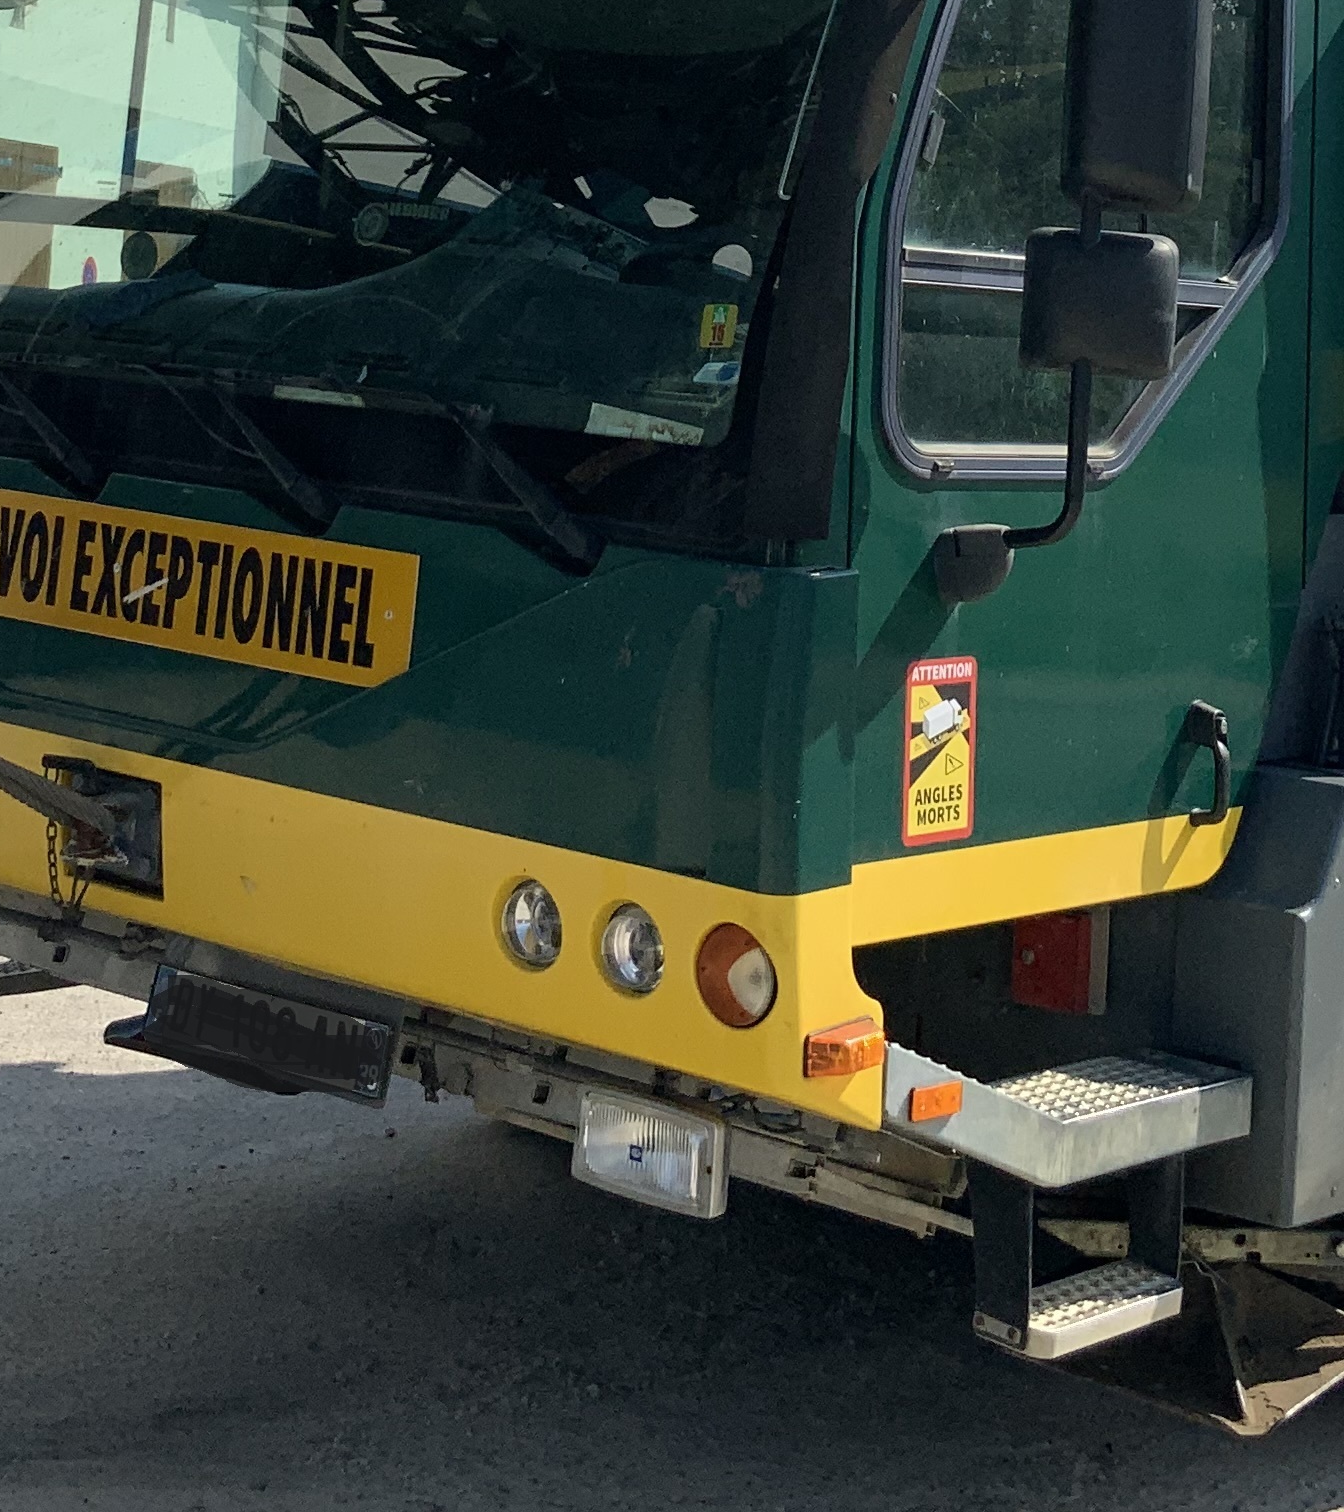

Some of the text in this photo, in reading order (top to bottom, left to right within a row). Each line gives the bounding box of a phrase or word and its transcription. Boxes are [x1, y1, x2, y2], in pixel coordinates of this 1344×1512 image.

[70, 519, 375, 669] EXCEPTIONNEL
[912, 662, 973, 682] ATTENTION
[915, 784, 963, 806] ANGLES
[917, 804, 961, 827] MORTS
